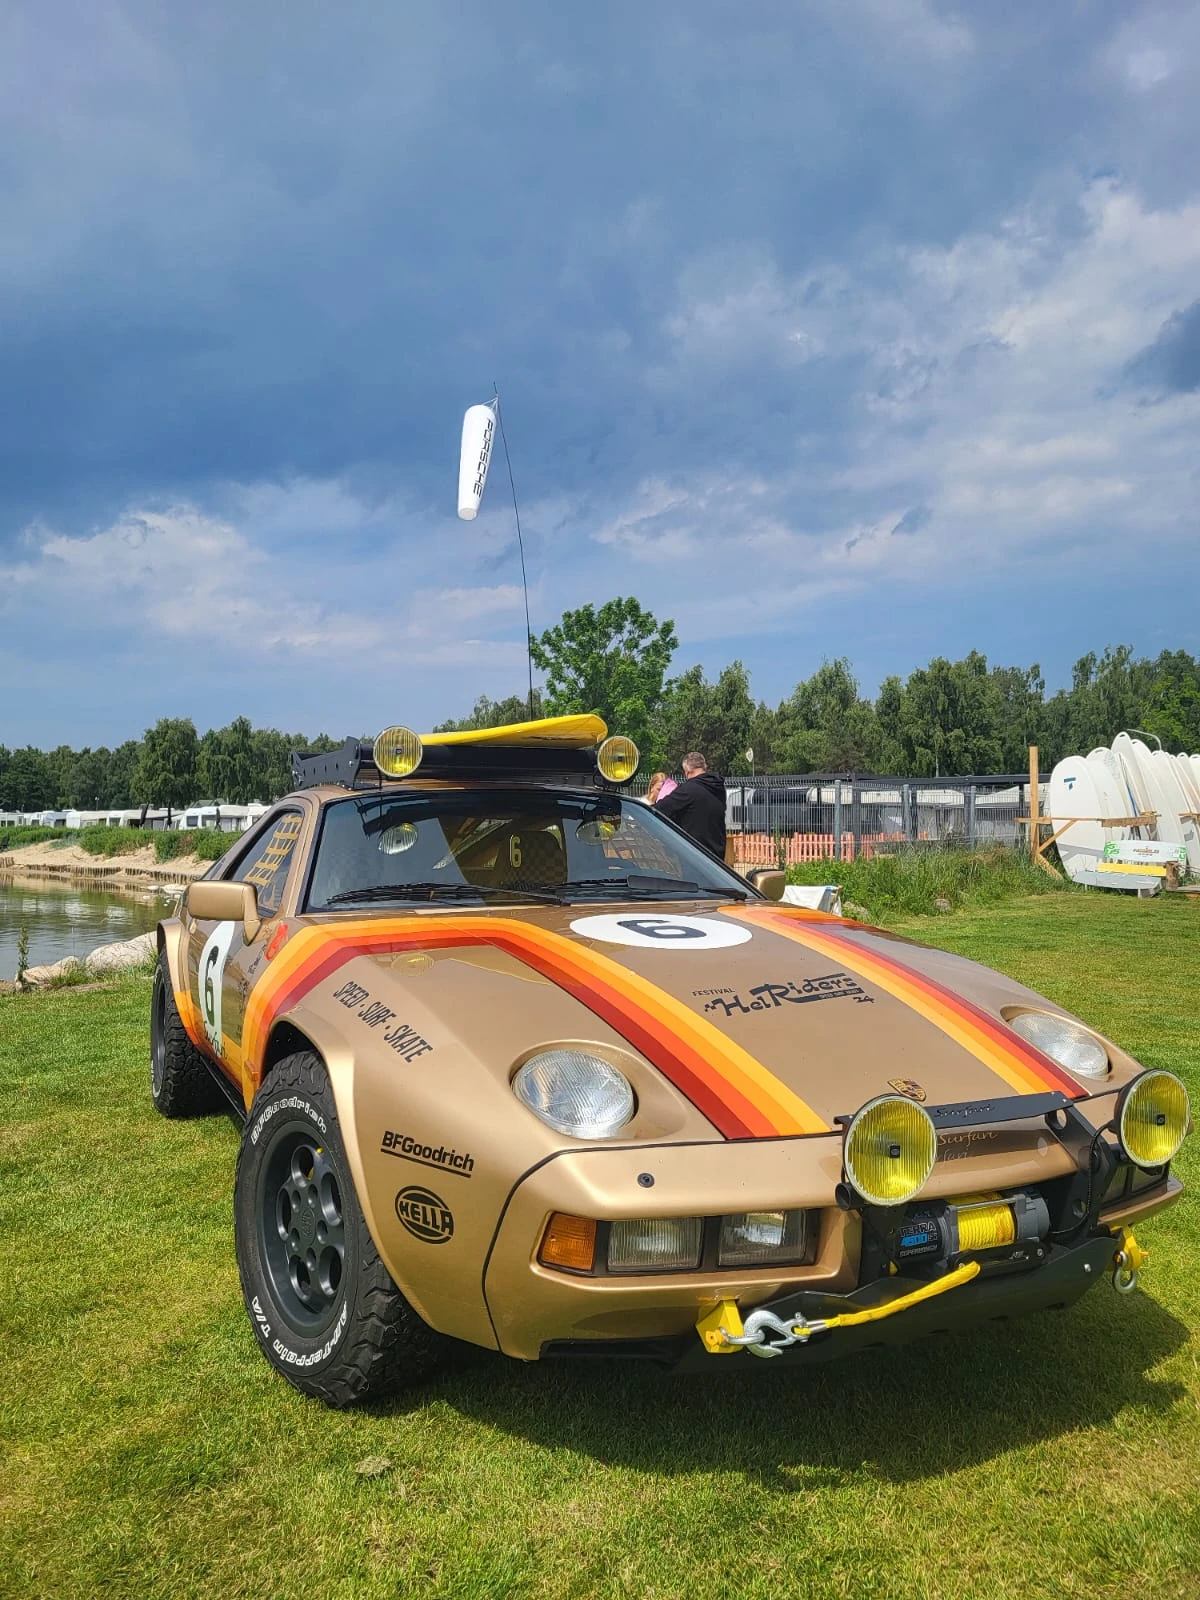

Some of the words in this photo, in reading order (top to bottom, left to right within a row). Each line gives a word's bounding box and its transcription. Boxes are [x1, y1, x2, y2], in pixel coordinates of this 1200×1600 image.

[473, 417, 495, 498] PORSCHE
[510, 835, 522, 868] 6
[616, 919, 707, 939] 6
[204, 945, 219, 1027] 6
[692, 987, 735, 997] FESTIVAL
[333, 981, 370, 1008] SPEED
[357, 1001, 397, 1028] SURF
[383, 1024, 433, 1063] SKATE
[251, 1096, 327, 1145] BFGoodrich
[382, 1130, 475, 1171] BFGoodrich
[399, 1200, 454, 1237] HELLA
[251, 1295, 272, 1338] T/A
[273, 1299, 347, 1366] All-Terrain
